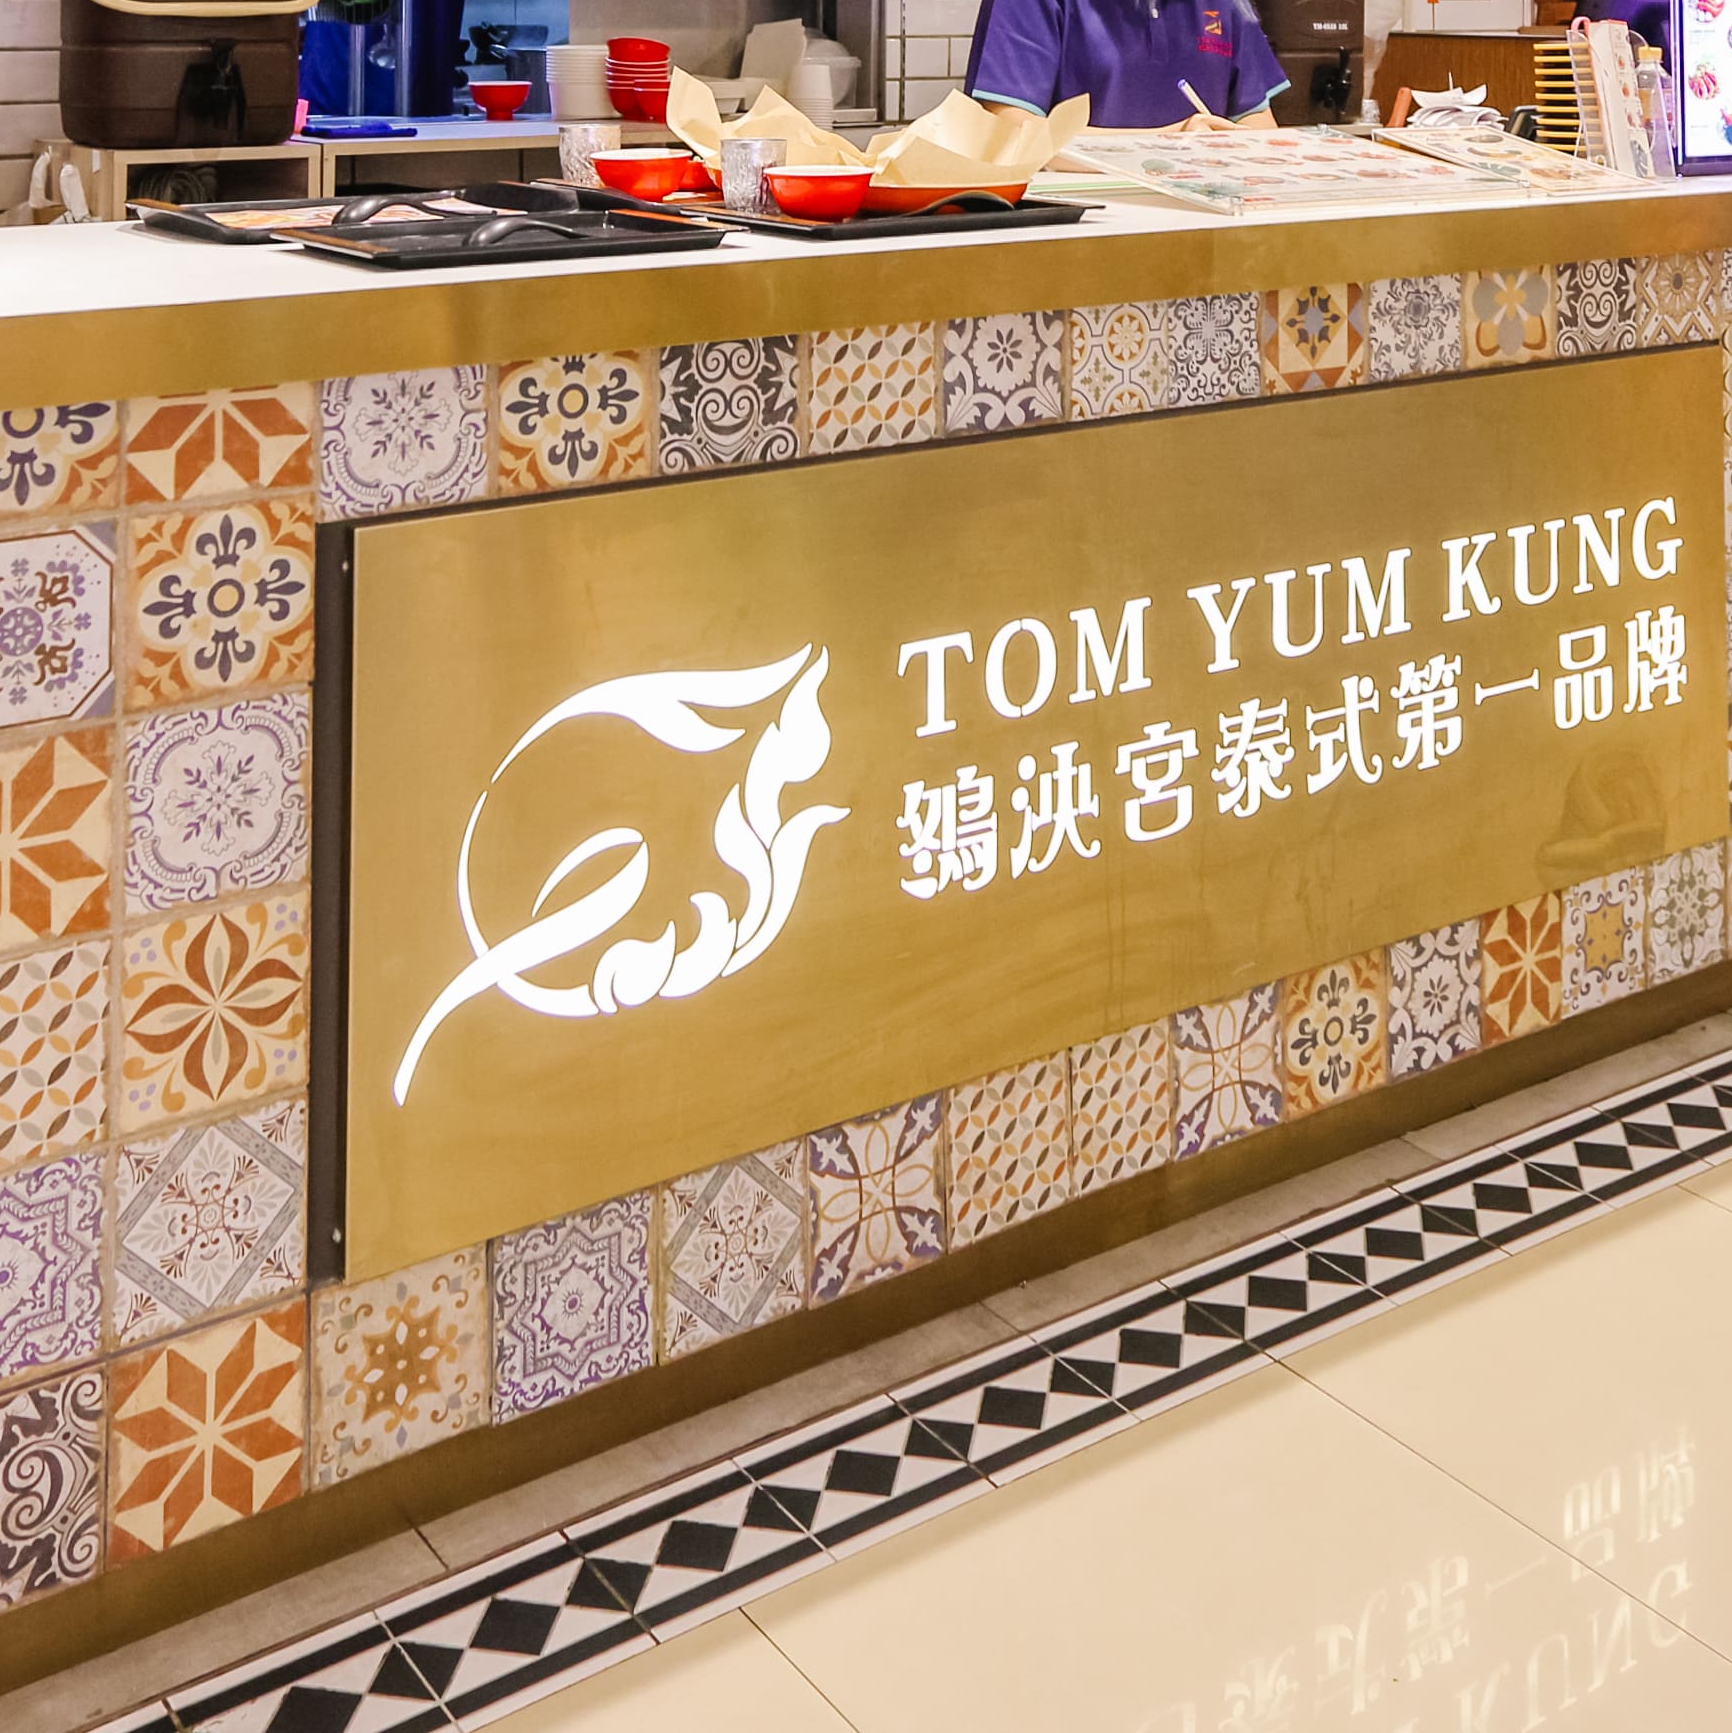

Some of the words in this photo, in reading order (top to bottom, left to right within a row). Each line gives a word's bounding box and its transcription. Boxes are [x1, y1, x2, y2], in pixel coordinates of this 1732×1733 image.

[896, 597, 1152, 739] TOM
[1187, 547, 1413, 672] YUM
[1441, 495, 1684, 619] KUNG
